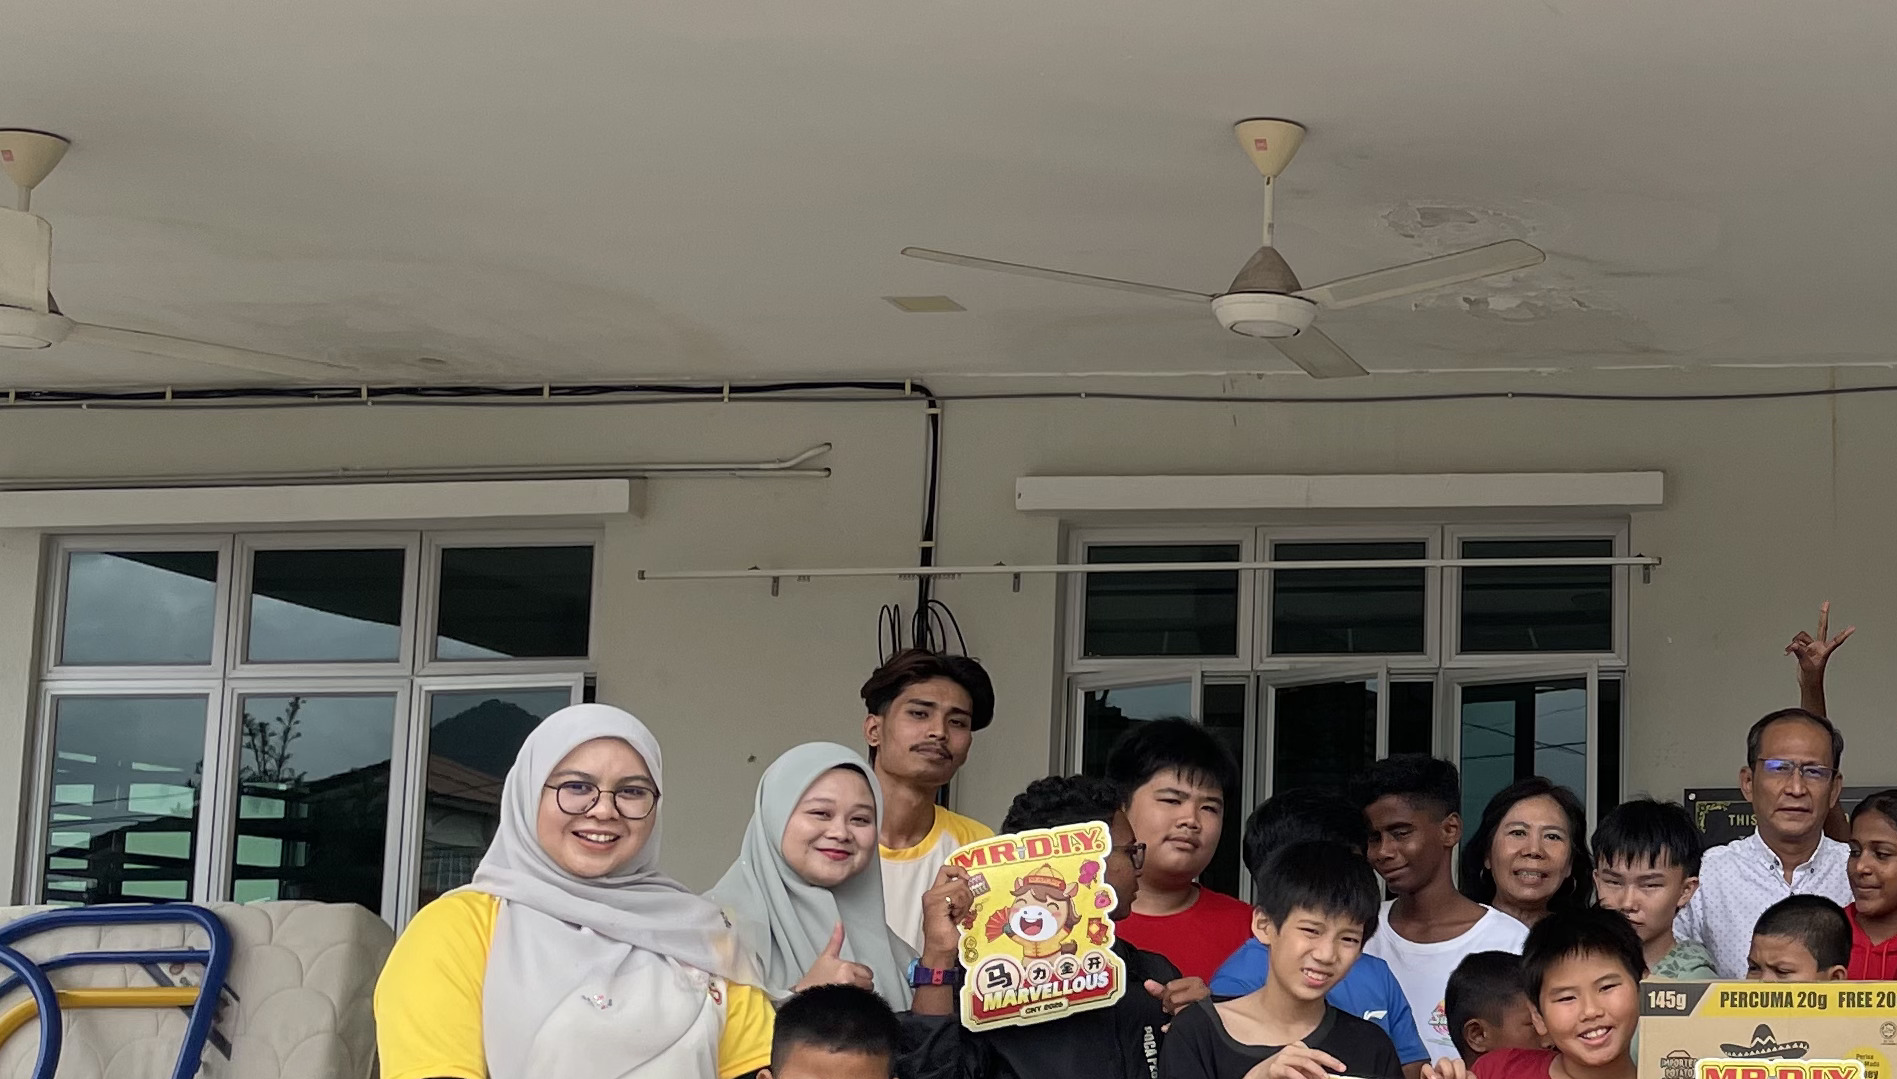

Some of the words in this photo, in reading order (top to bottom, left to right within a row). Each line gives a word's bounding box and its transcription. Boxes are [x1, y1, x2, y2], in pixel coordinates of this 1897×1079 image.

[1728, 814, 1758, 827] THIS
[986, 956, 1104, 989] 马力全开
[983, 970, 1110, 1013] MARVELLOUS
[1648, 990, 1687, 1010] 145g
[1720, 991, 1793, 1009] PERCUMA
[1797, 991, 1828, 1011] 20g
[1838, 991, 1873, 1009] FREE
